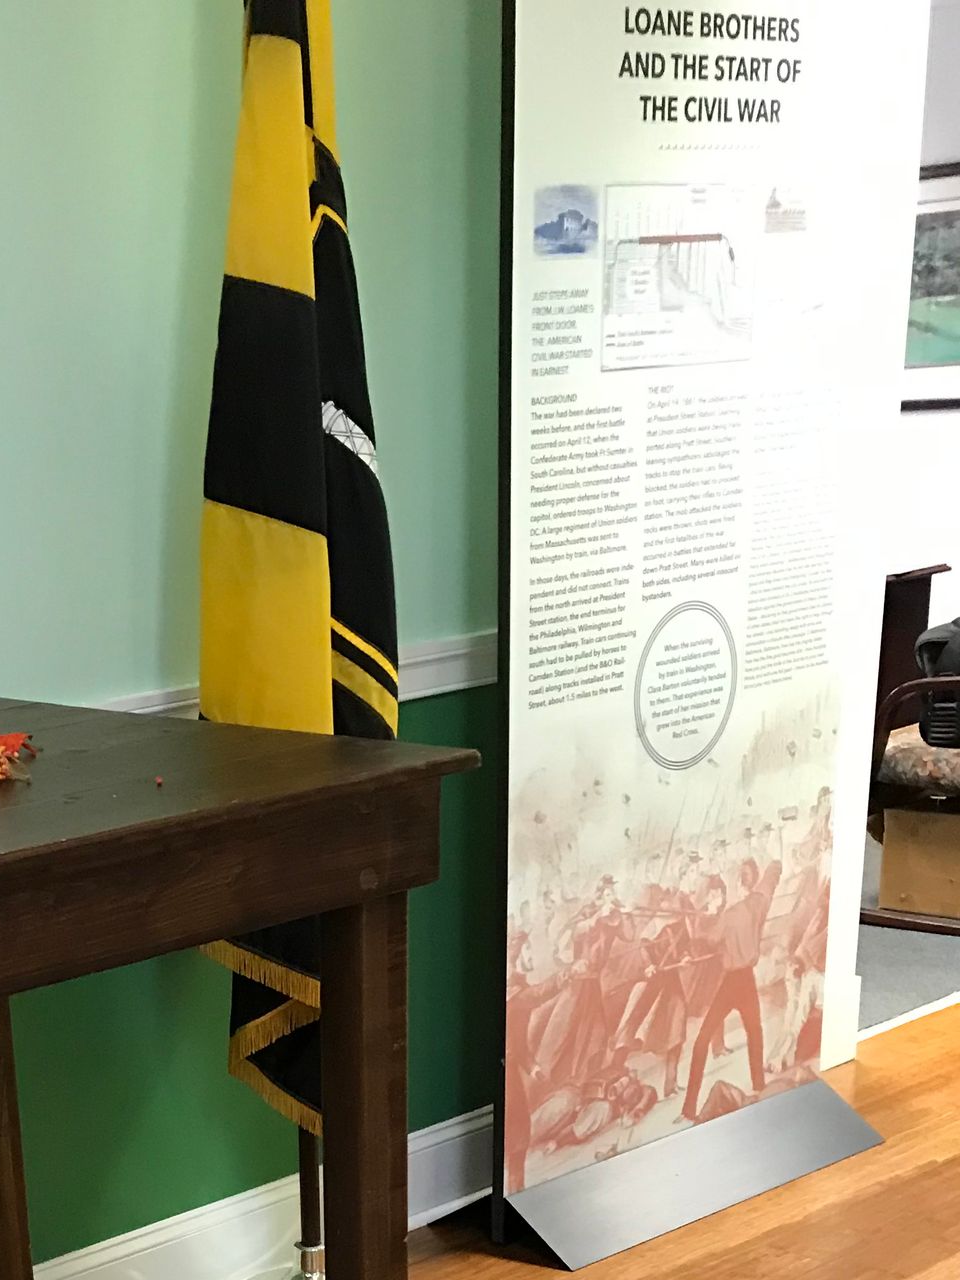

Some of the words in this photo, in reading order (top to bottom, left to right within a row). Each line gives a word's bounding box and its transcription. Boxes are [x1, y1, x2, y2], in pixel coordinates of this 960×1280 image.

[625, 7, 693, 37] LOANE
[700, 12, 800, 43] BROTHERS
[618, 51, 665, 79] AND
[671, 53, 708, 81] THE
[715, 55, 772, 82] START
[777, 58, 802, 83] OF
[640, 96, 678, 122] THE
[684, 96, 732, 123] CIVIL
[738, 98, 781, 123] WAR
[532, 338, 544, 346] THE
[547, 336, 582, 345] AMERICAN
[531, 394, 577, 405] BACKGROUND
